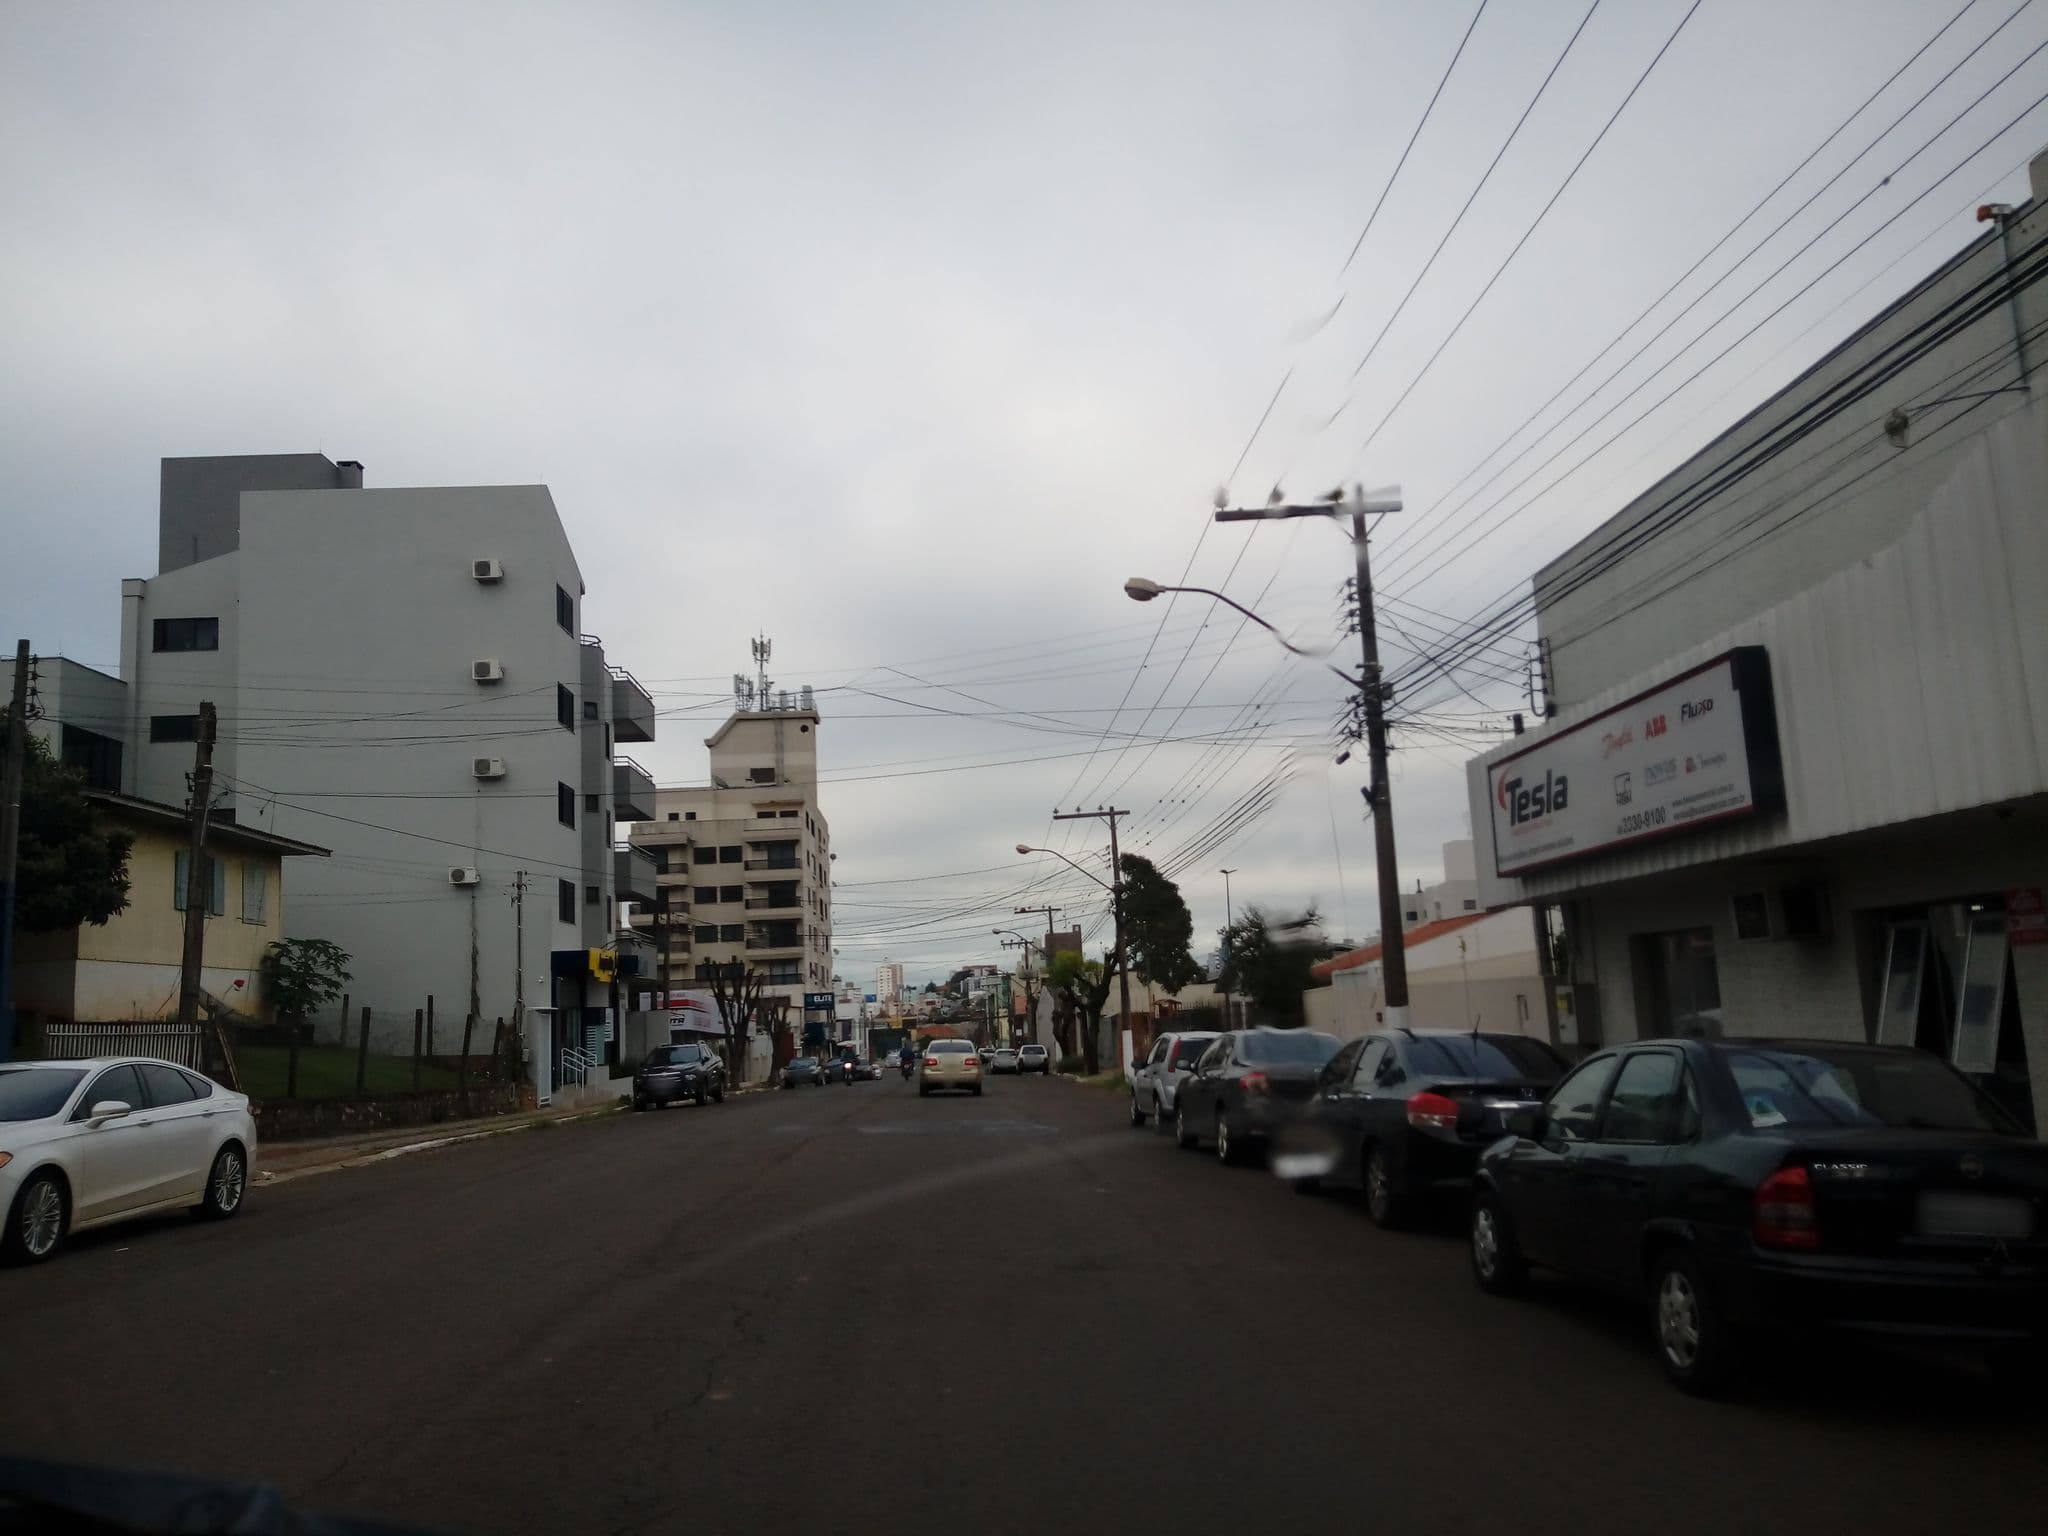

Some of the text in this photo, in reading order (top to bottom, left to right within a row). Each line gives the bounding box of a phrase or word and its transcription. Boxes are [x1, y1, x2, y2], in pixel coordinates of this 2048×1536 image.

[1680, 697, 1714, 723] Fluxo
[1645, 714, 1668, 738] ABB
[1504, 768, 1568, 826] Tesla
[1622, 806, 1667, 833] 3330-9100
[813, 994, 833, 1002] ELITE
